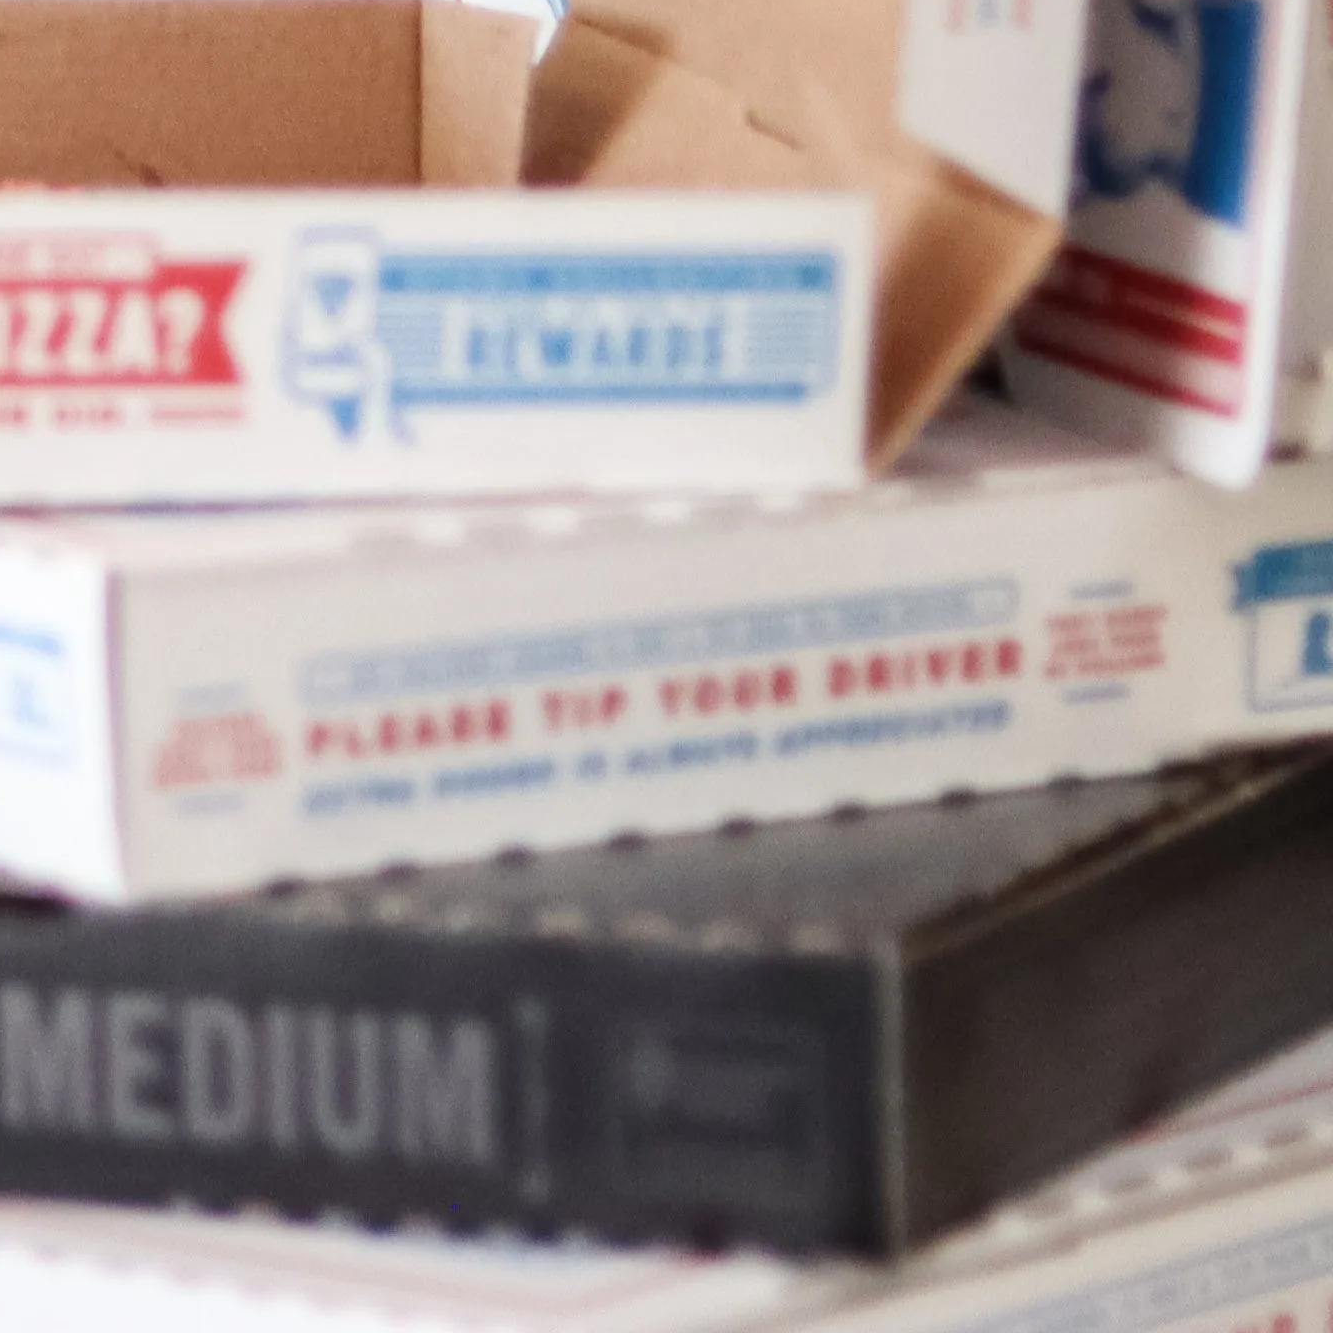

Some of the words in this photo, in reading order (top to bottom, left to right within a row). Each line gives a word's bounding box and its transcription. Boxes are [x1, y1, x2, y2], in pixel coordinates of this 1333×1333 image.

[305, 697, 512, 760] PLEASE
[541, 684, 629, 732] TIP
[657, 663, 798, 715] YOUR
[829, 637, 1023, 700] DRIVER
